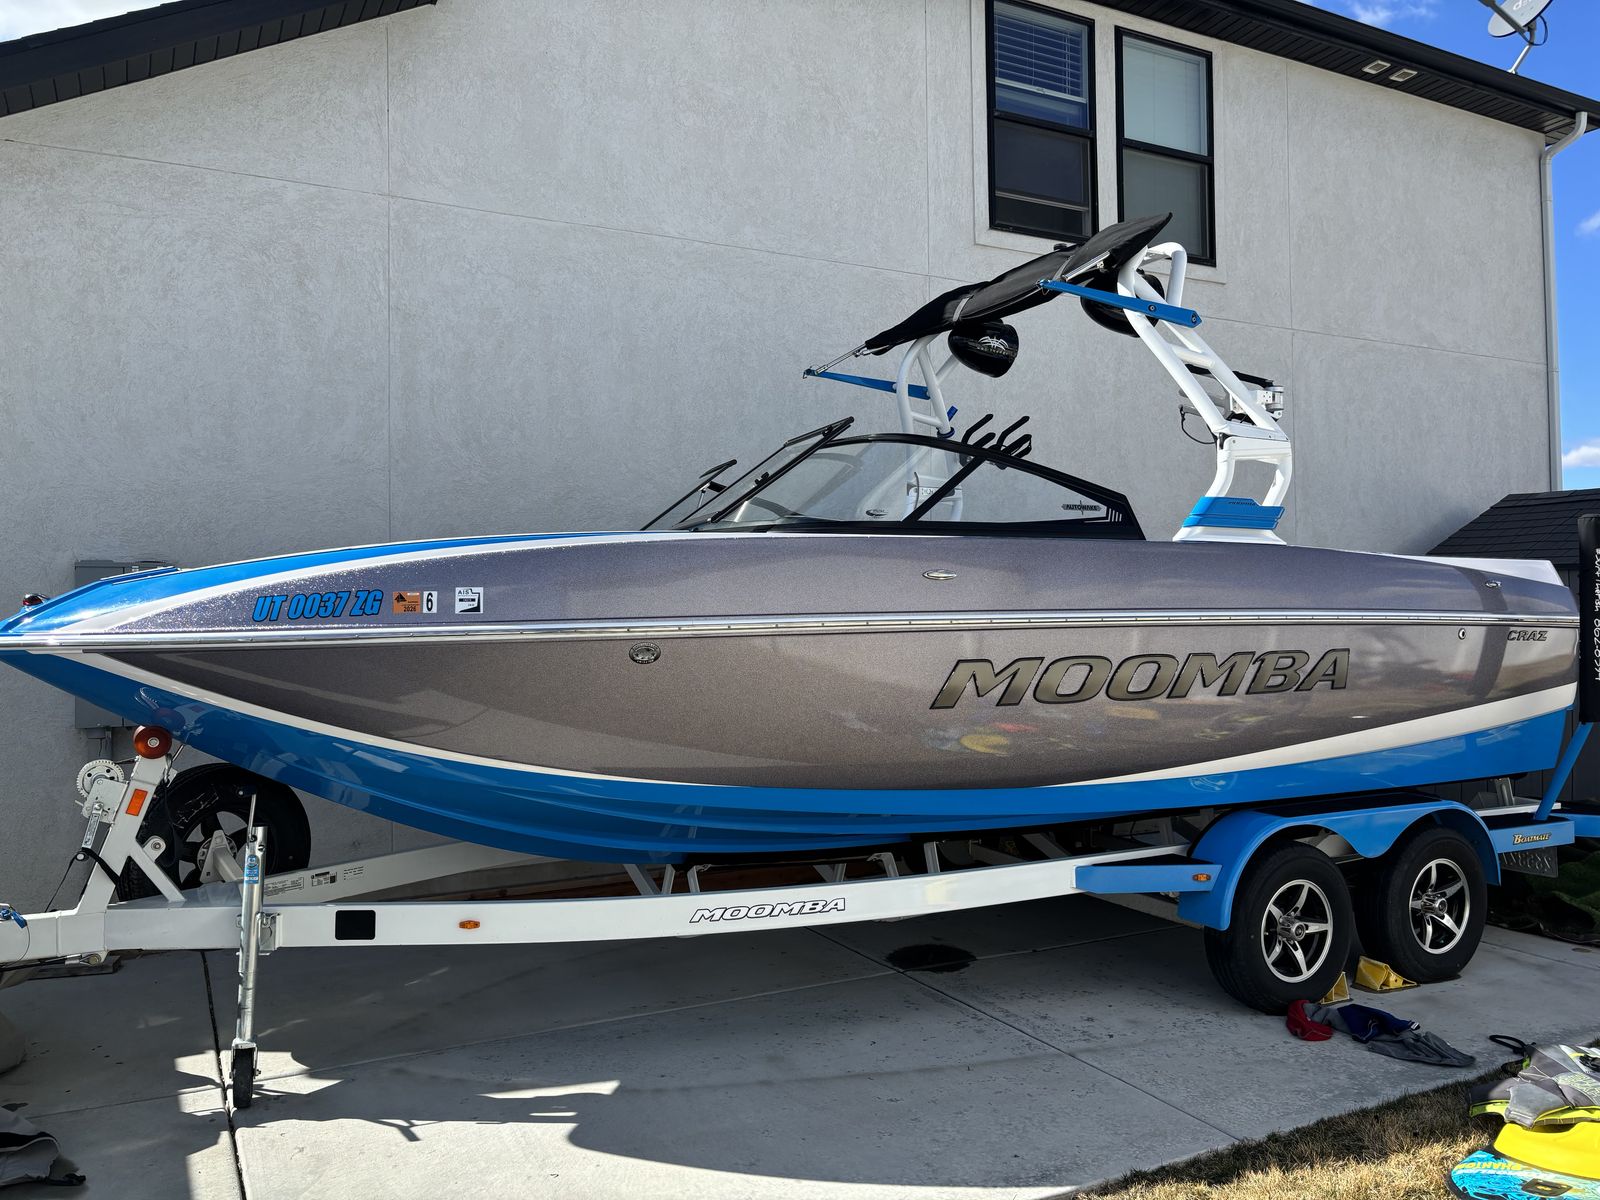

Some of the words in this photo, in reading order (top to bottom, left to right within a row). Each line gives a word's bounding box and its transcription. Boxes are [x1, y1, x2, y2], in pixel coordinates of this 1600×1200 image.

[252, 594, 288, 622] UT
[287, 591, 351, 620] 0037
[349, 589, 384, 617] ZG
[426, 592, 433, 612] 6
[1507, 630, 1548, 641] CRAZ
[929, 648, 1350, 710] MOOMBA
[689, 898, 845, 923] MOOMBA
